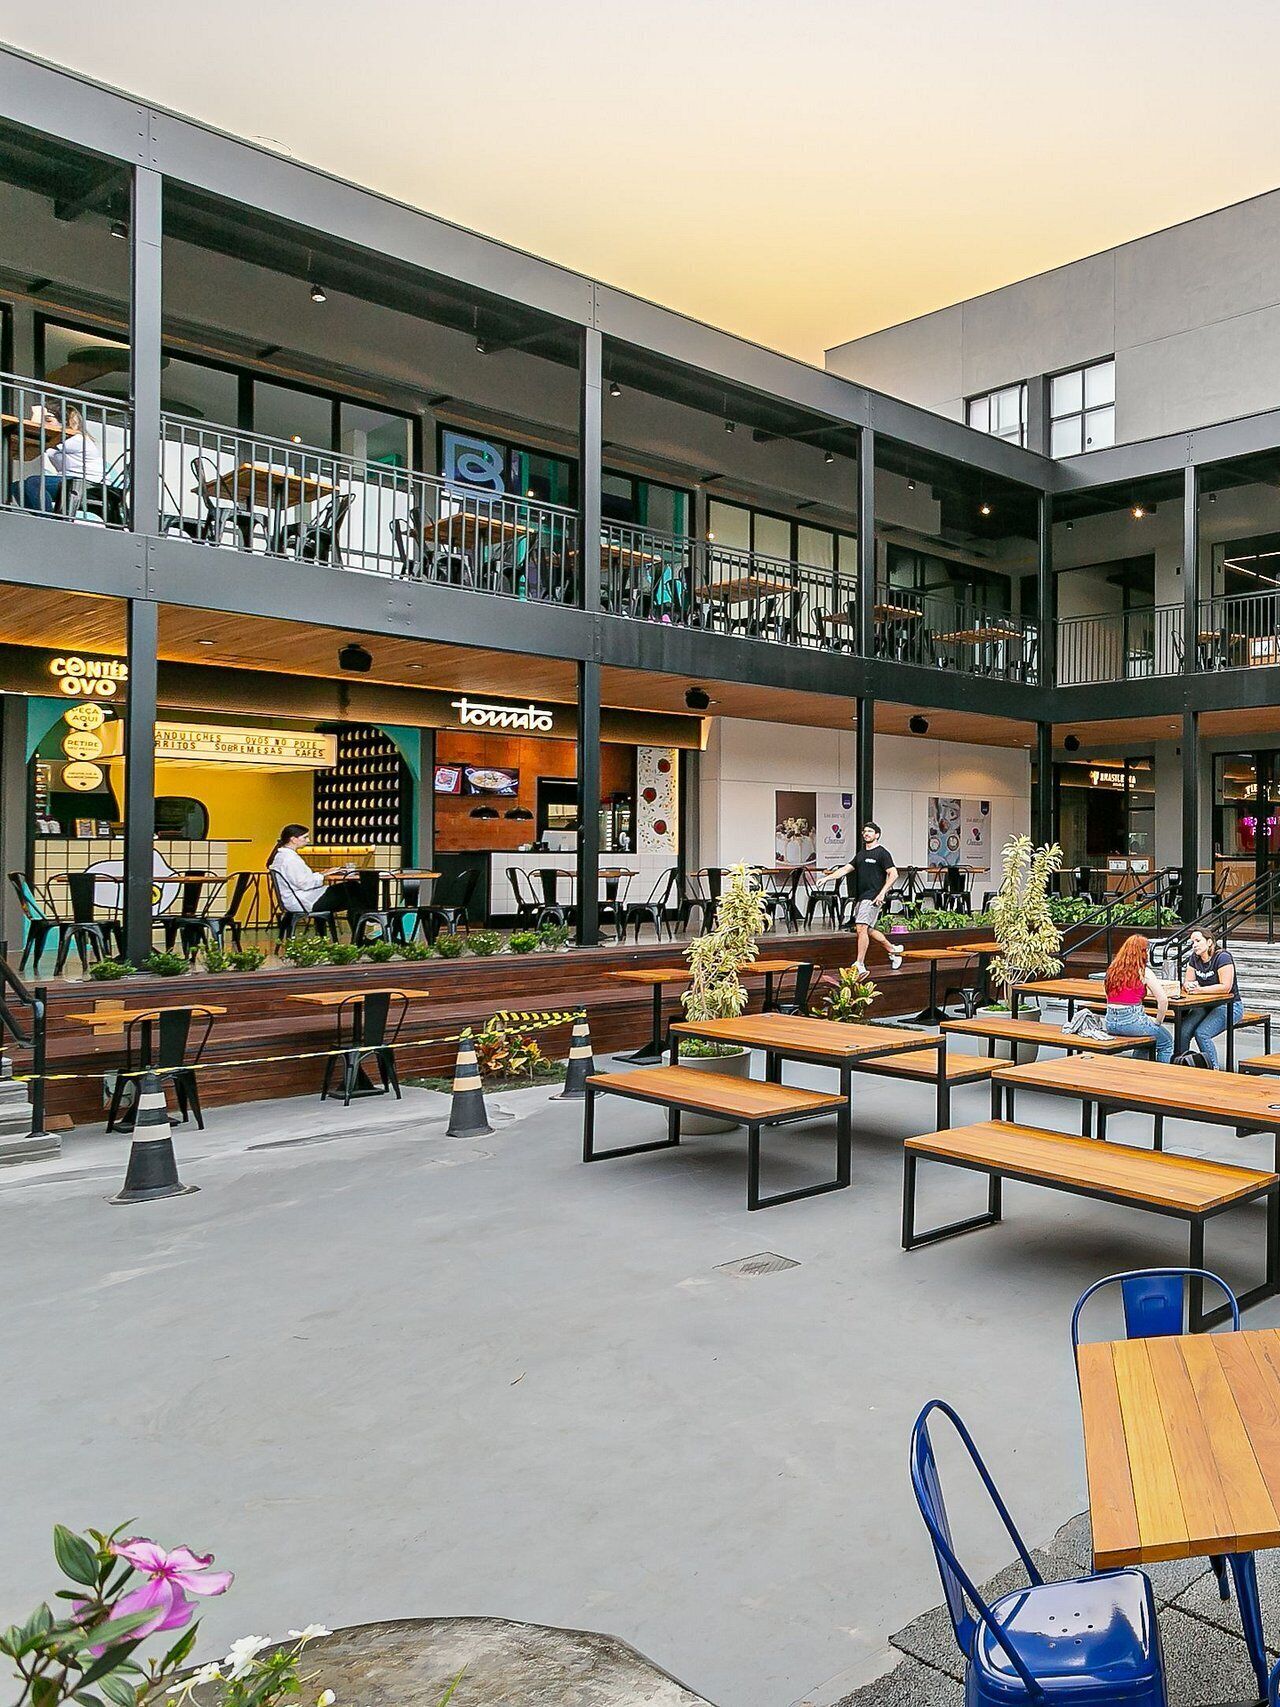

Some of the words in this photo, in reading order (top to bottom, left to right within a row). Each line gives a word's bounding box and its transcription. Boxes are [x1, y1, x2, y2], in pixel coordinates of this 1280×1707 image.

[60, 676, 117, 696] OVO
[450, 697, 553, 732] tomato
[154, 730, 222, 743] ANDUICHES
[245, 735, 270, 745] OVOS
[214, 742, 284, 755] SOBREMESAS
